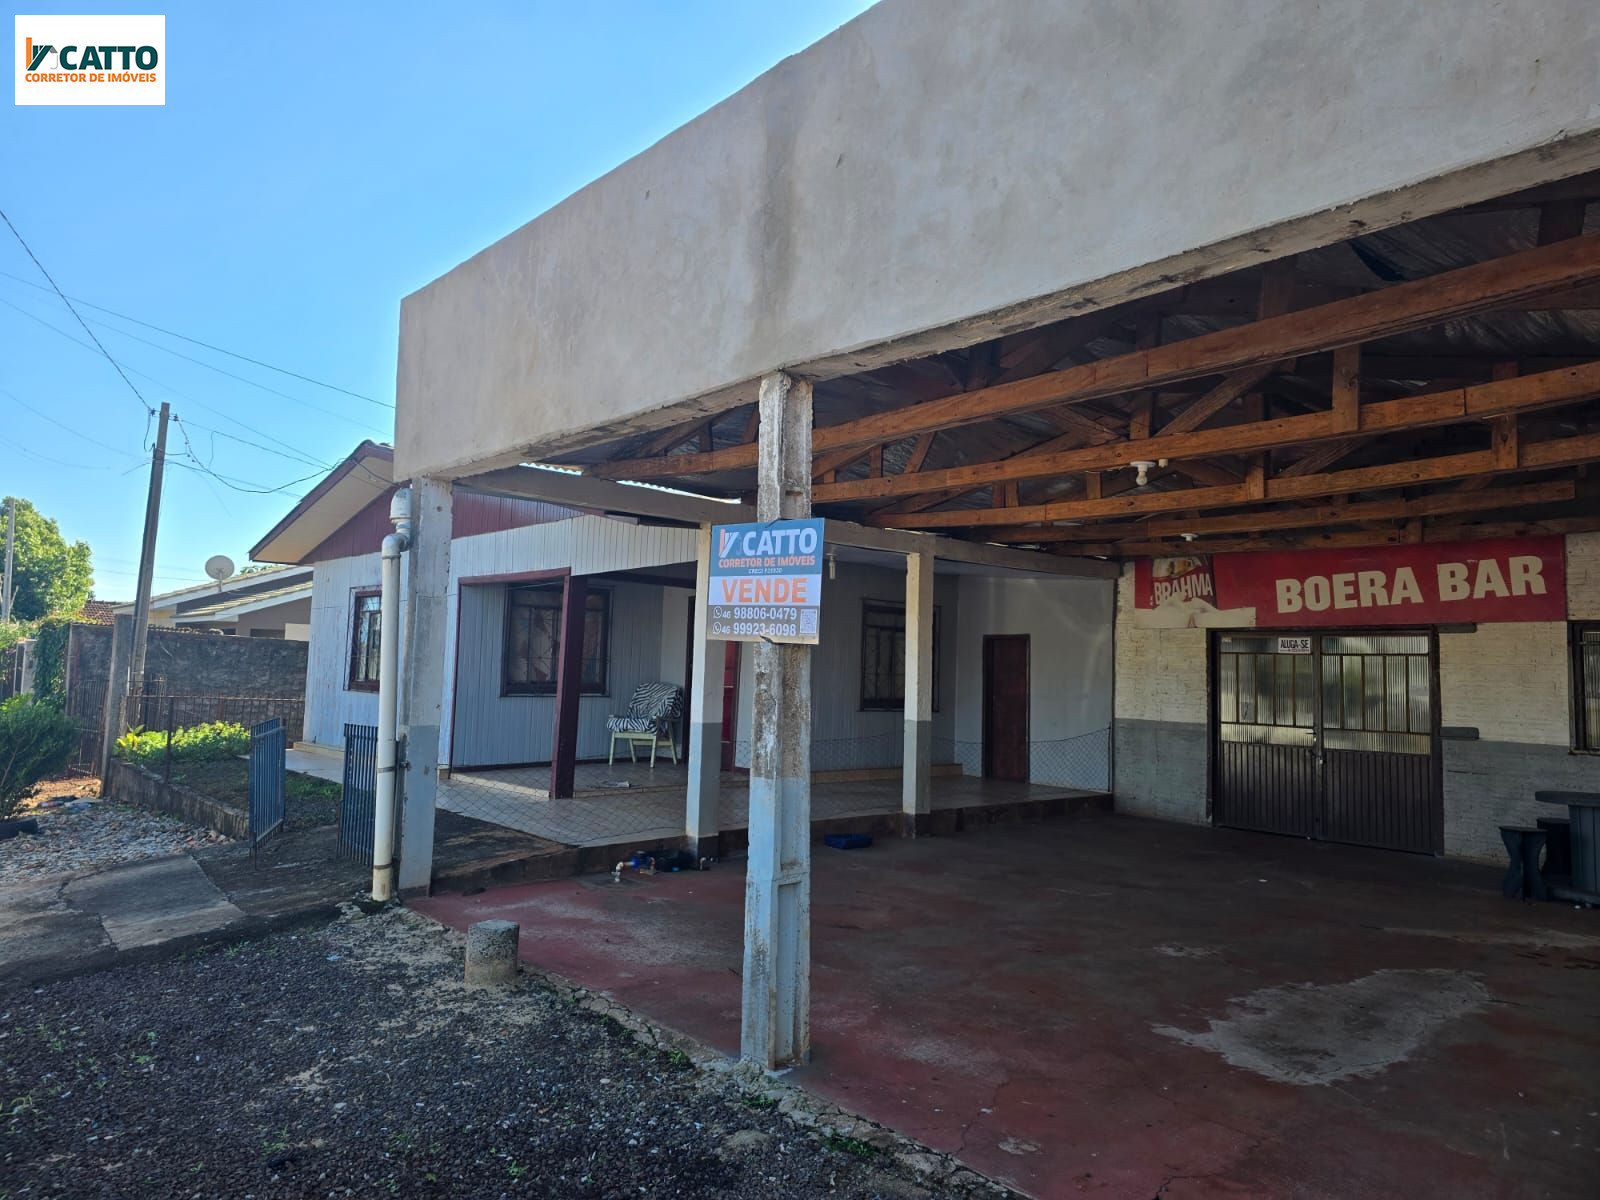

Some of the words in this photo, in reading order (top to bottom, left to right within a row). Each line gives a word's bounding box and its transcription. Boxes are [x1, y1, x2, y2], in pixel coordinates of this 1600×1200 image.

[742, 527, 818, 556] CATTO
[718, 557, 763, 569] CORRETOR
[764, 556, 776, 567] DE
[777, 555, 816, 567] IMÓVEIS
[721, 577, 809, 603] VENDE
[1153, 573, 1214, 605] BRAHMA
[1275, 566, 1424, 613] BOERA
[1437, 555, 1548, 601] BAR
[722, 611, 731, 619] 46
[734, 607, 797, 620] 98806-0479
[721, 626, 731, 634] 46
[733, 622, 797, 636] 99923-6098
[1280, 639, 1309, 648] ALUGA-SE
